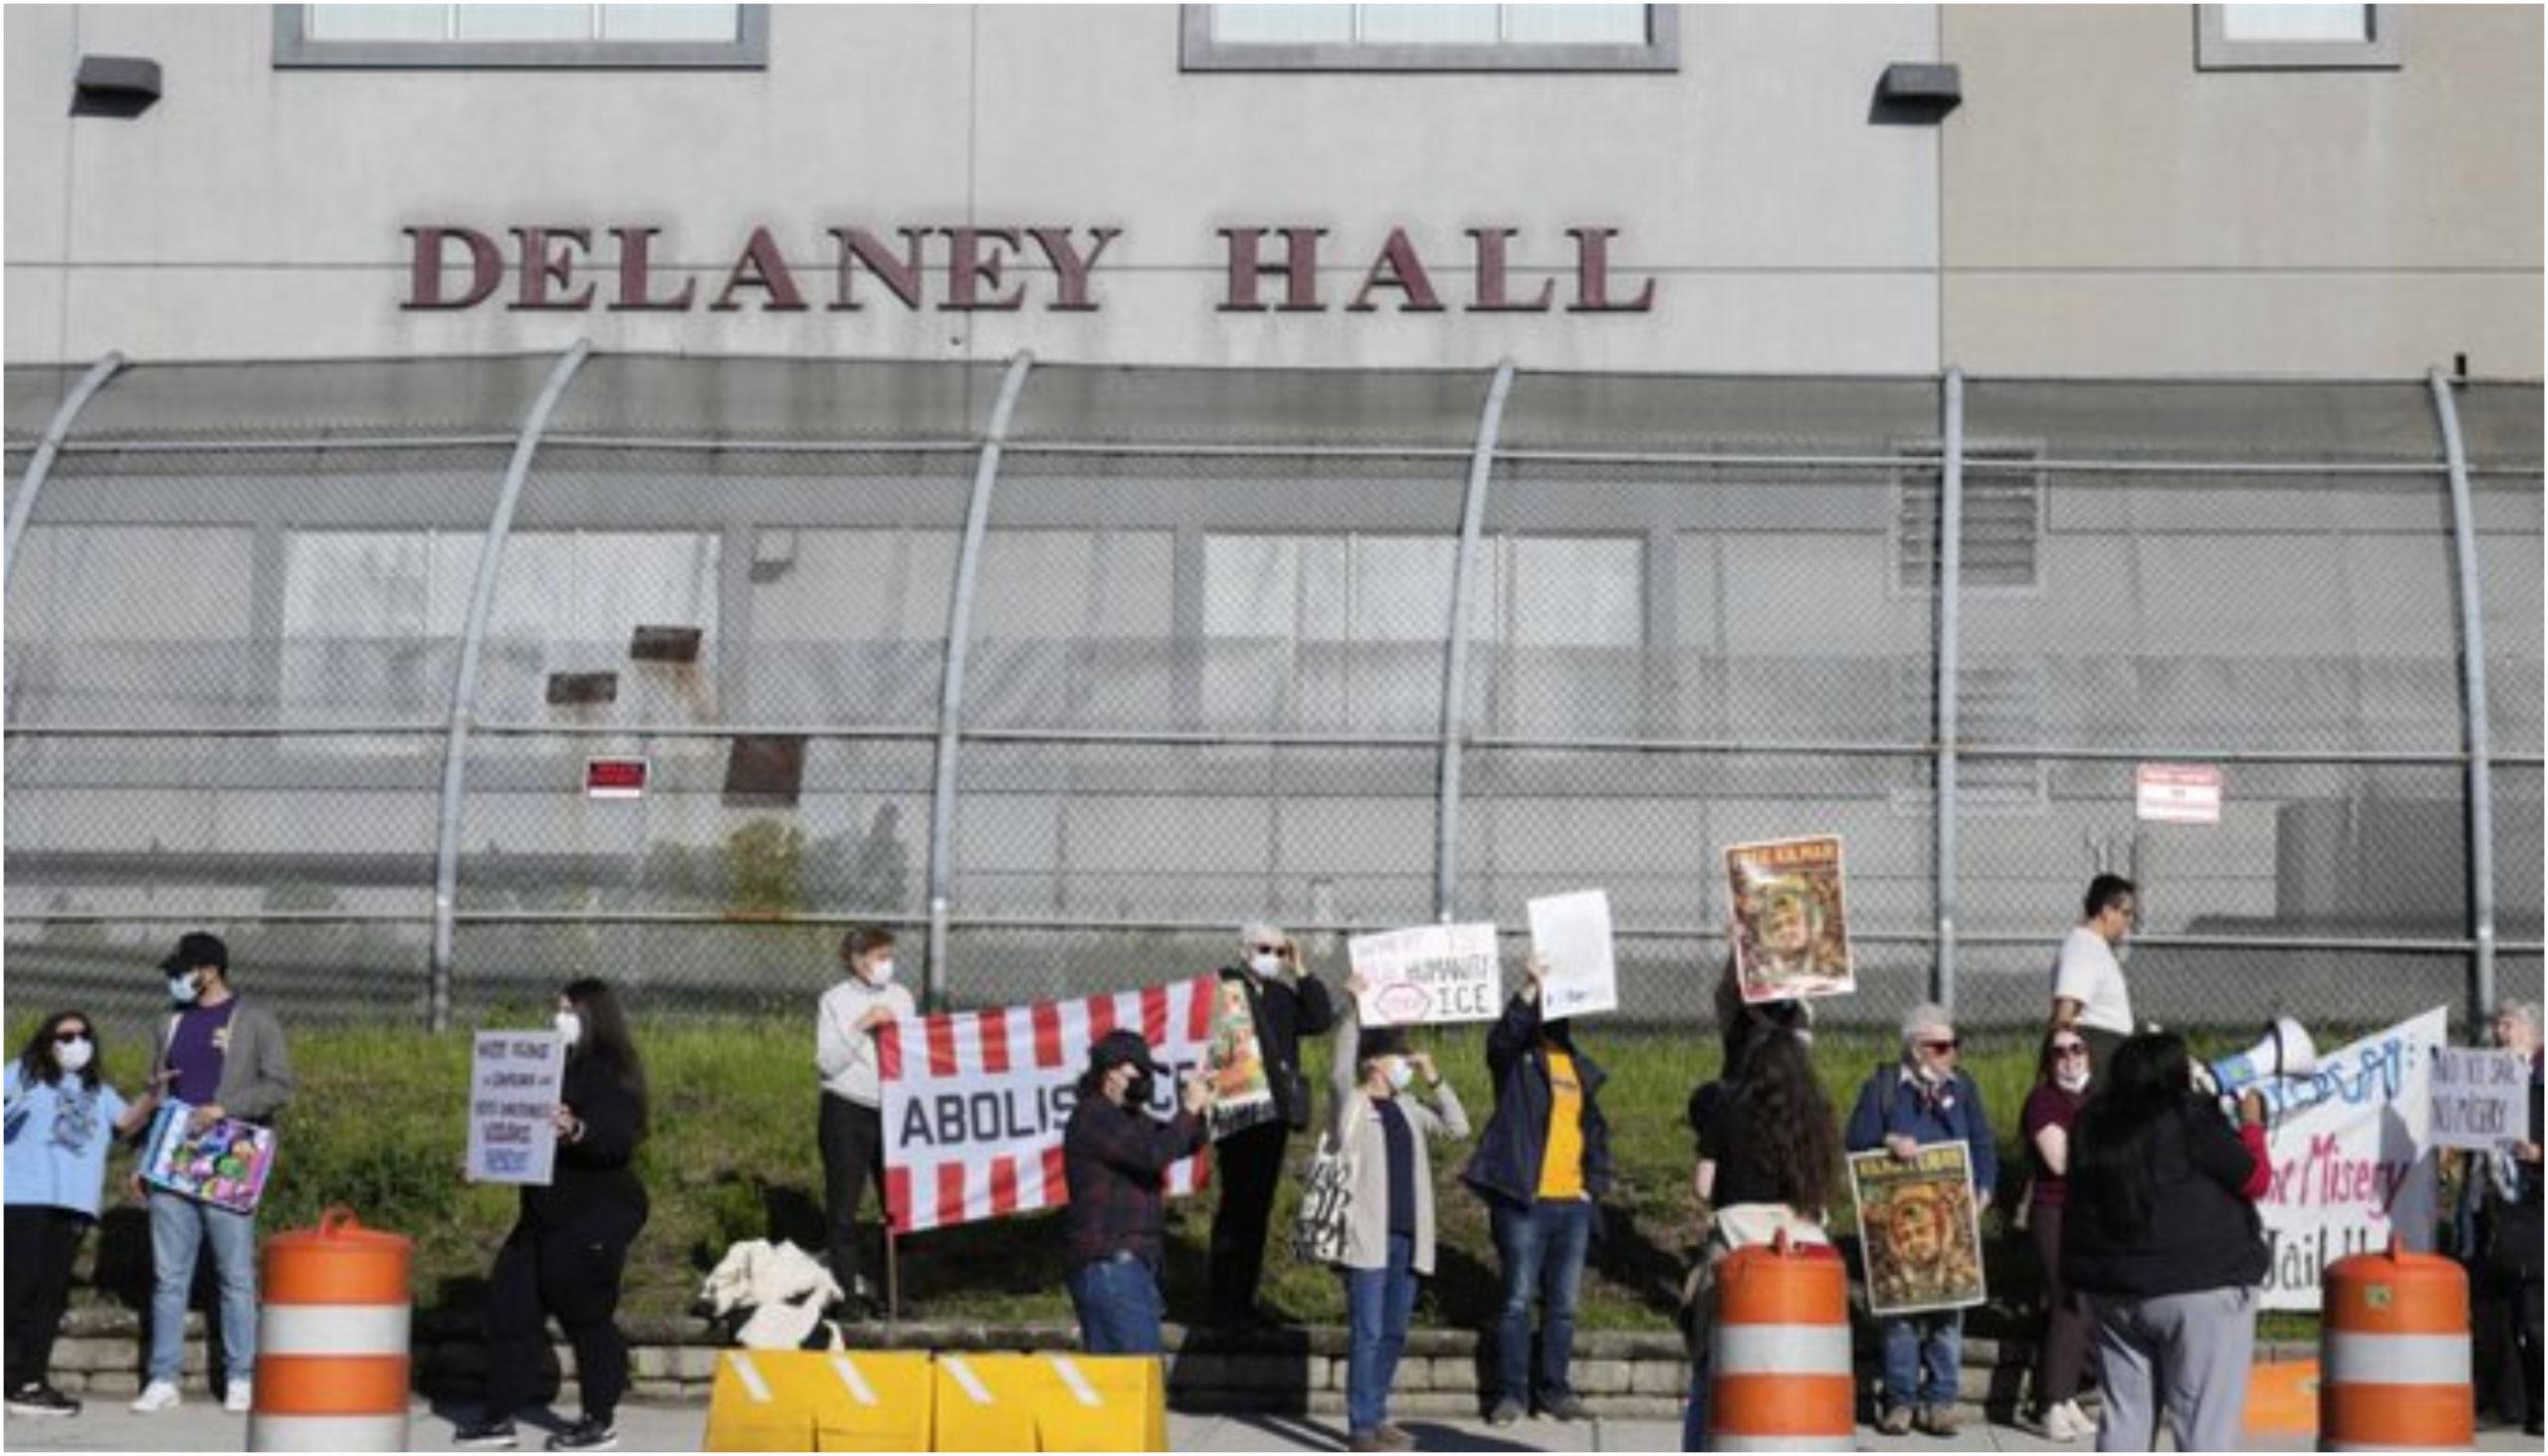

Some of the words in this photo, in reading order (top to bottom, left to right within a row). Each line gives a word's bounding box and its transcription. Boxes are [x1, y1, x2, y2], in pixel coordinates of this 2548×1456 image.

[399, 226, 1123, 312] DELANEY
[1215, 227, 1656, 312] HALL
[1436, 982, 1492, 1015] ICE
[900, 1083, 1079, 1147] ABOLIS
[2299, 1132, 2415, 1220] Misery
[2260, 1226, 2327, 1290] Jail
